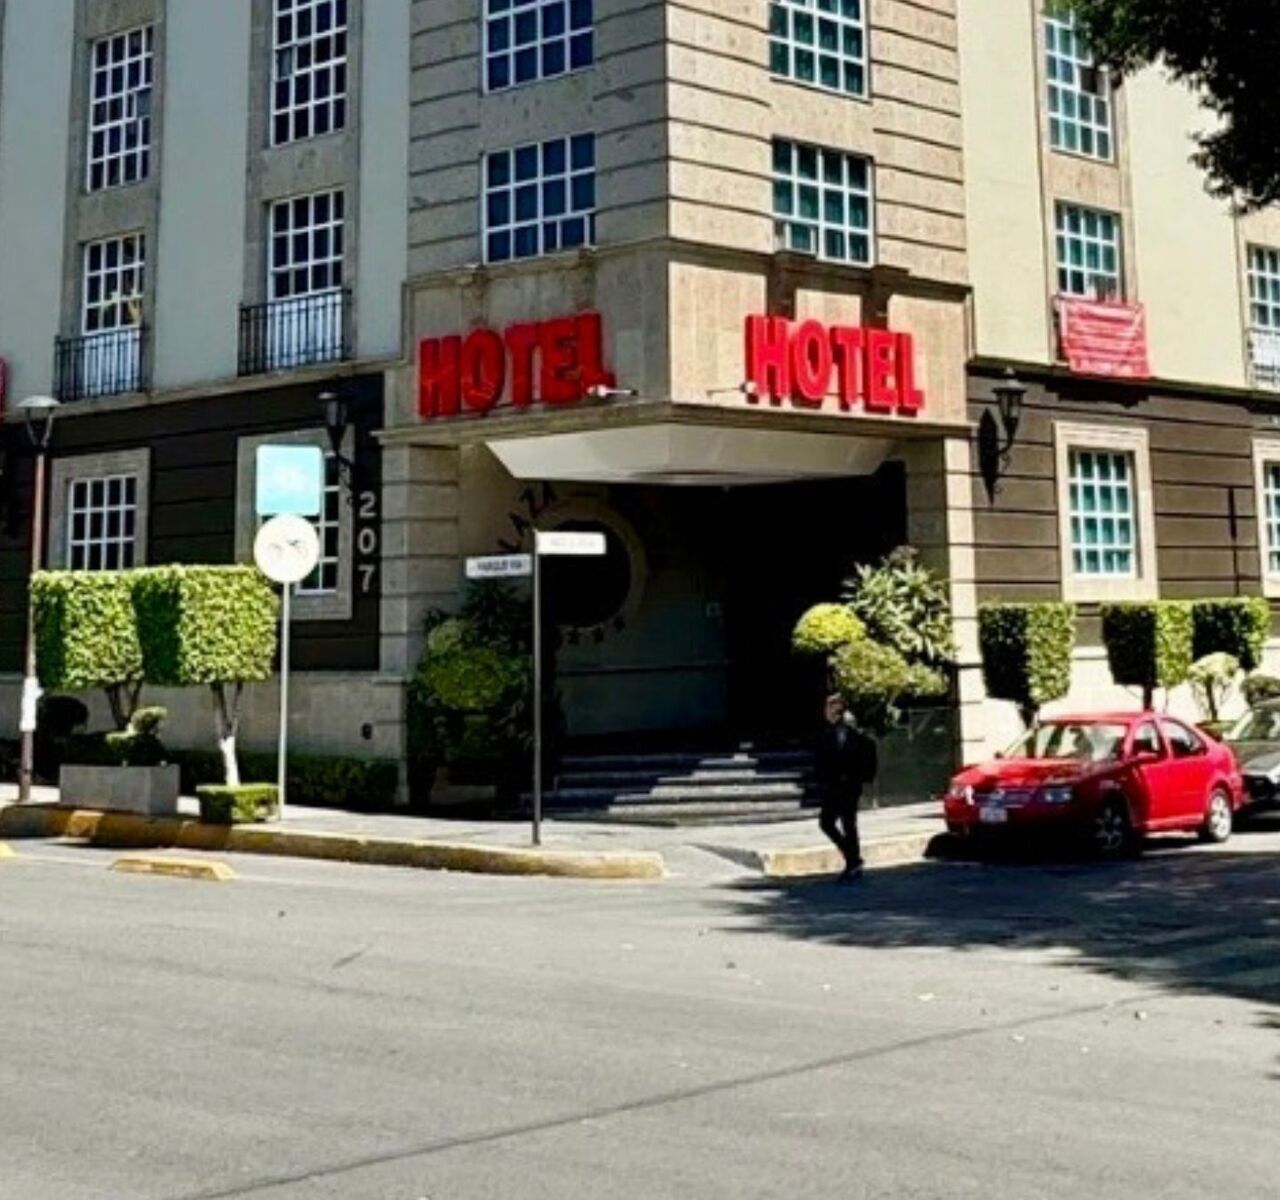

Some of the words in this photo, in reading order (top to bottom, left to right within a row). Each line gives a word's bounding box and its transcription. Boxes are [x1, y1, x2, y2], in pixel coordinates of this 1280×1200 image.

[418, 312, 616, 418] HOTEL
[744, 313, 925, 413] HOTEL
[357, 490, 377, 593] 207
